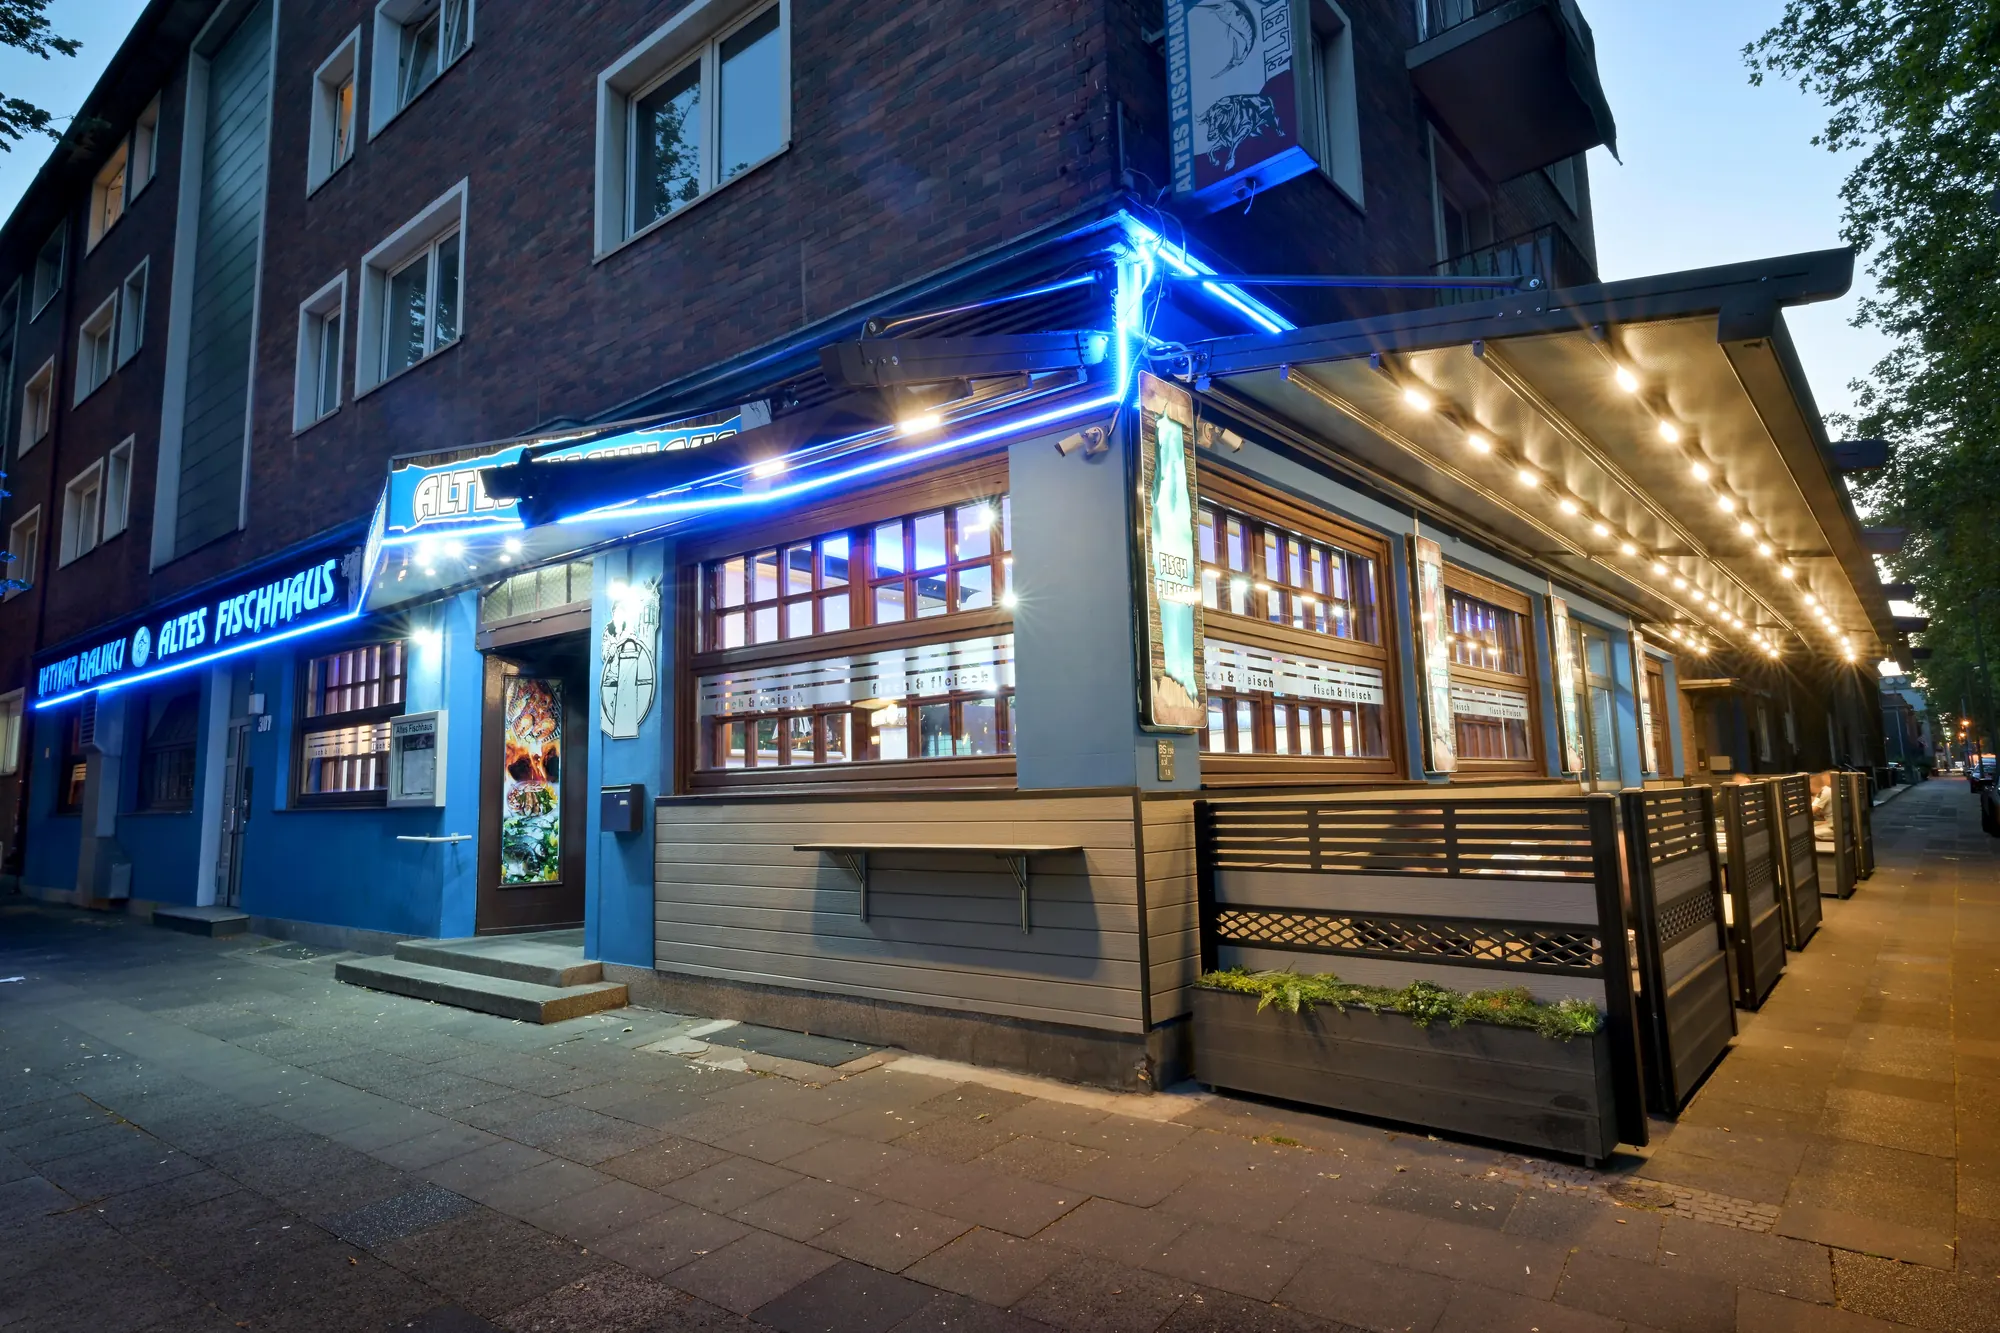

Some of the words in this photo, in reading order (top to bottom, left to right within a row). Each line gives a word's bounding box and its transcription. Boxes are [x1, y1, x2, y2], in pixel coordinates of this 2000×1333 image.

[1173, 123, 1192, 193] ALTES
[1158, 551, 1188, 580] FISCH
[157, 606, 208, 660] ALTES
[214, 558, 337, 645] FISCHHAUS
[1313, 683, 1336, 697] fisch
[1337, 687, 1343, 697] &
[1344, 688, 1372, 701] fleisch
[408, 722, 433, 733] Fischhaus
